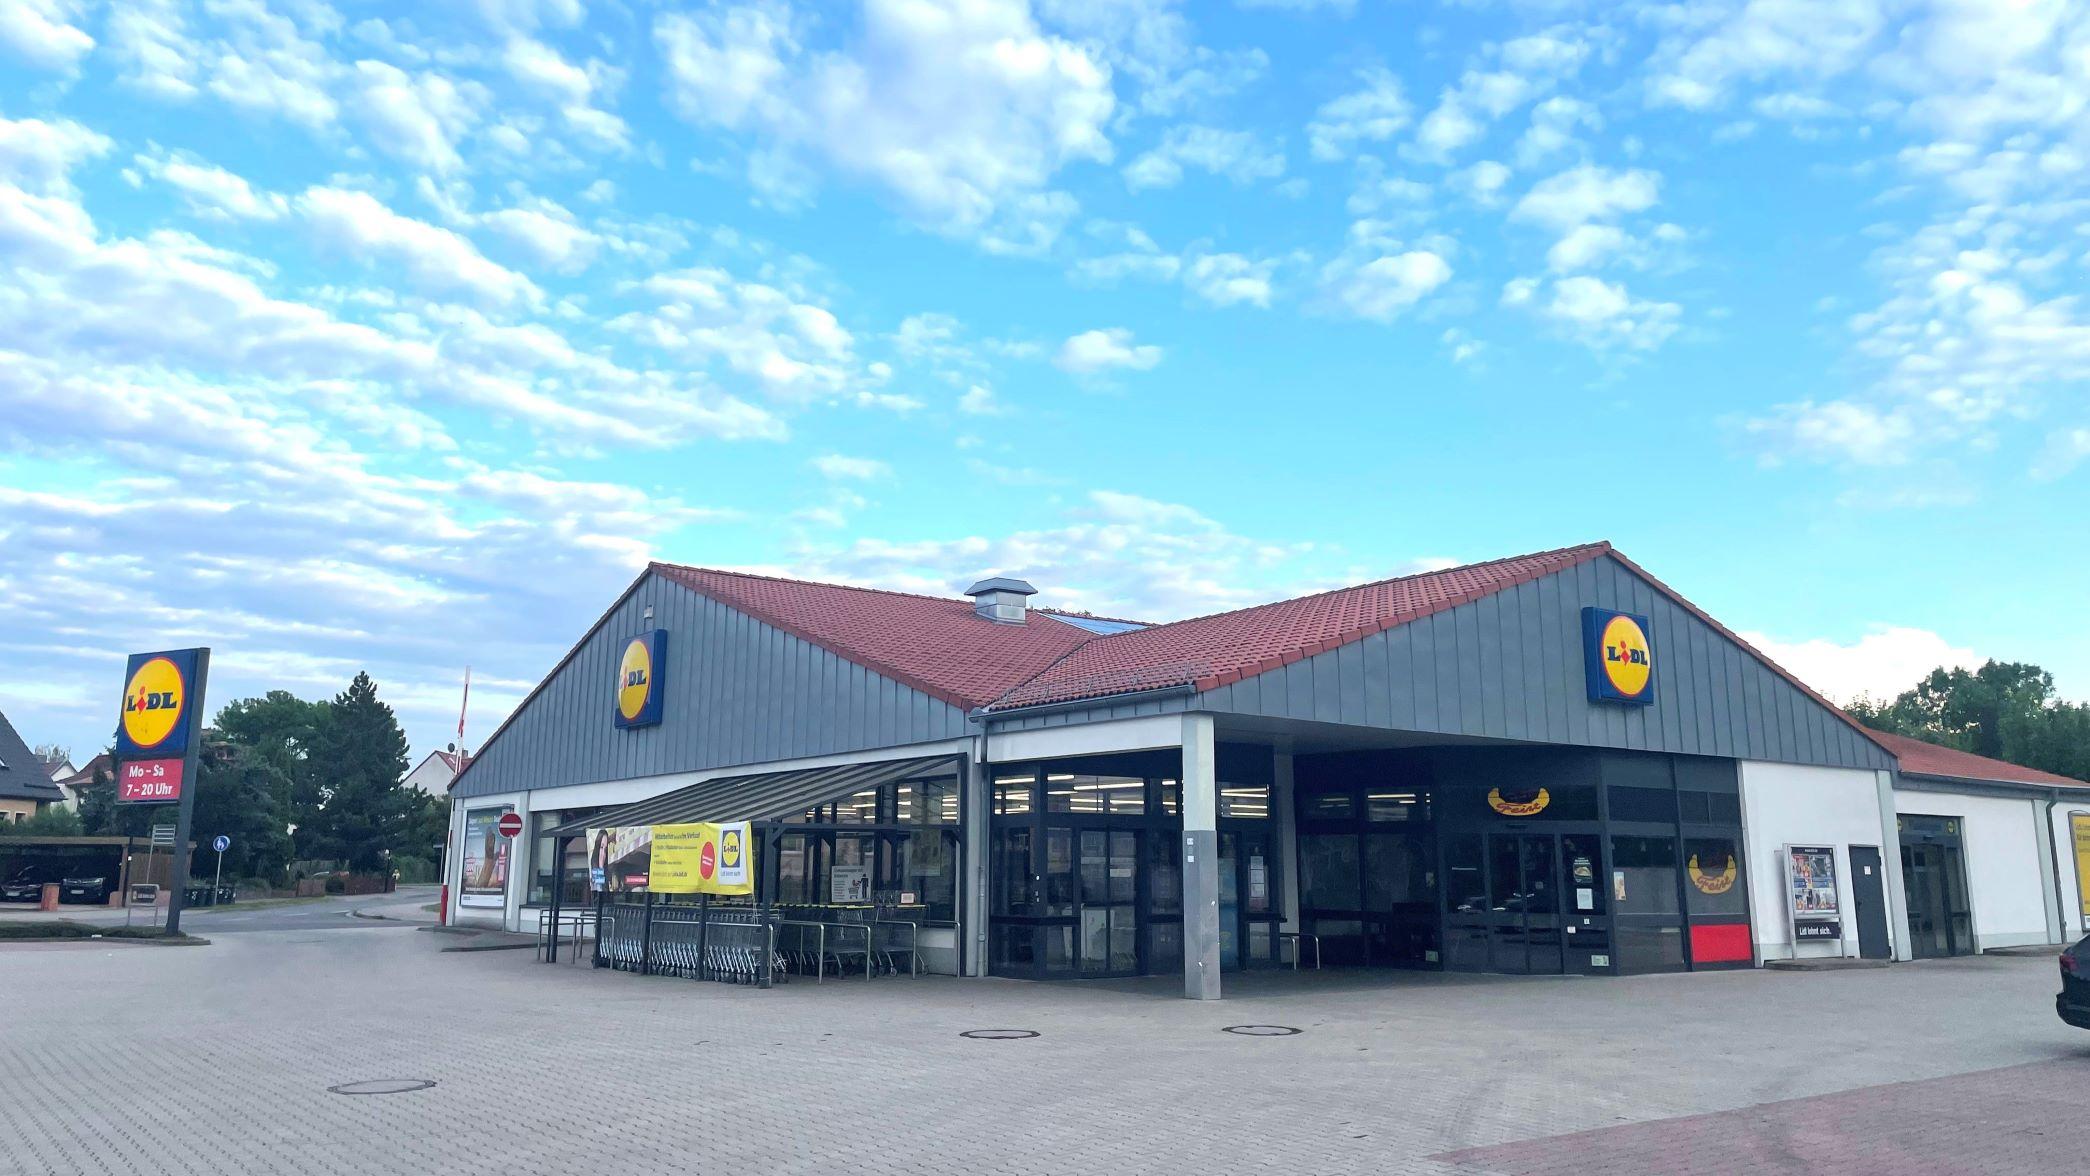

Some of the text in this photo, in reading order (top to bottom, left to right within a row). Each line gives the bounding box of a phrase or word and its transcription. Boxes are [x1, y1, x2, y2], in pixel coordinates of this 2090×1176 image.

[129, 765, 144, 778] Mo
[153, 764, 164, 777] Sa
[155, 782, 173, 796] Uhr
